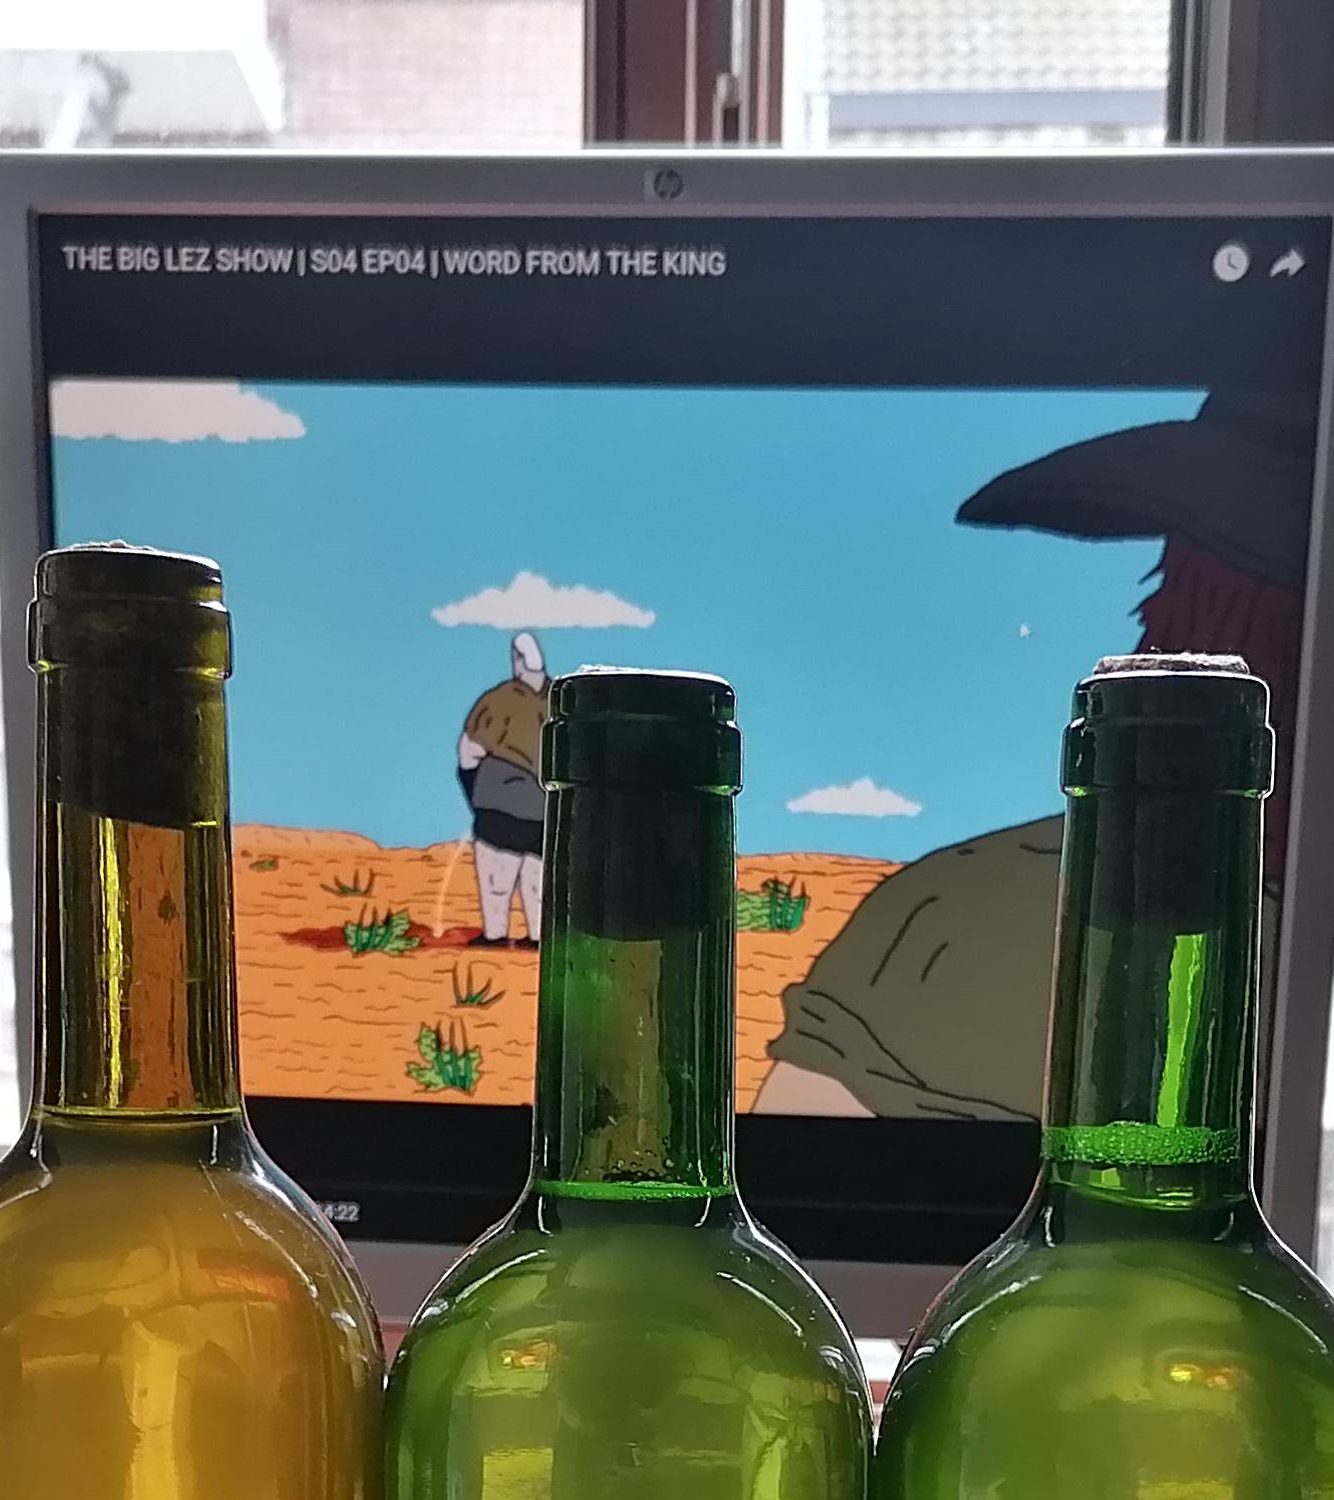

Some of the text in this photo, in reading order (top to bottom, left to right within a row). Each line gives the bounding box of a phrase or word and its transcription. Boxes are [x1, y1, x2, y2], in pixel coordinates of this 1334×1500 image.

[62, 245, 113, 271] THE
[116, 245, 160, 272] BIG
[164, 246, 212, 272] LEZ
[215, 247, 294, 273] SHOW
[310, 248, 358, 273] S04
[361, 248, 425, 273] EP04
[442, 249, 520, 275] WORD
[524, 249, 600, 276] FROM
[605, 249, 658, 276] THE
[662, 250, 727, 276] KING
